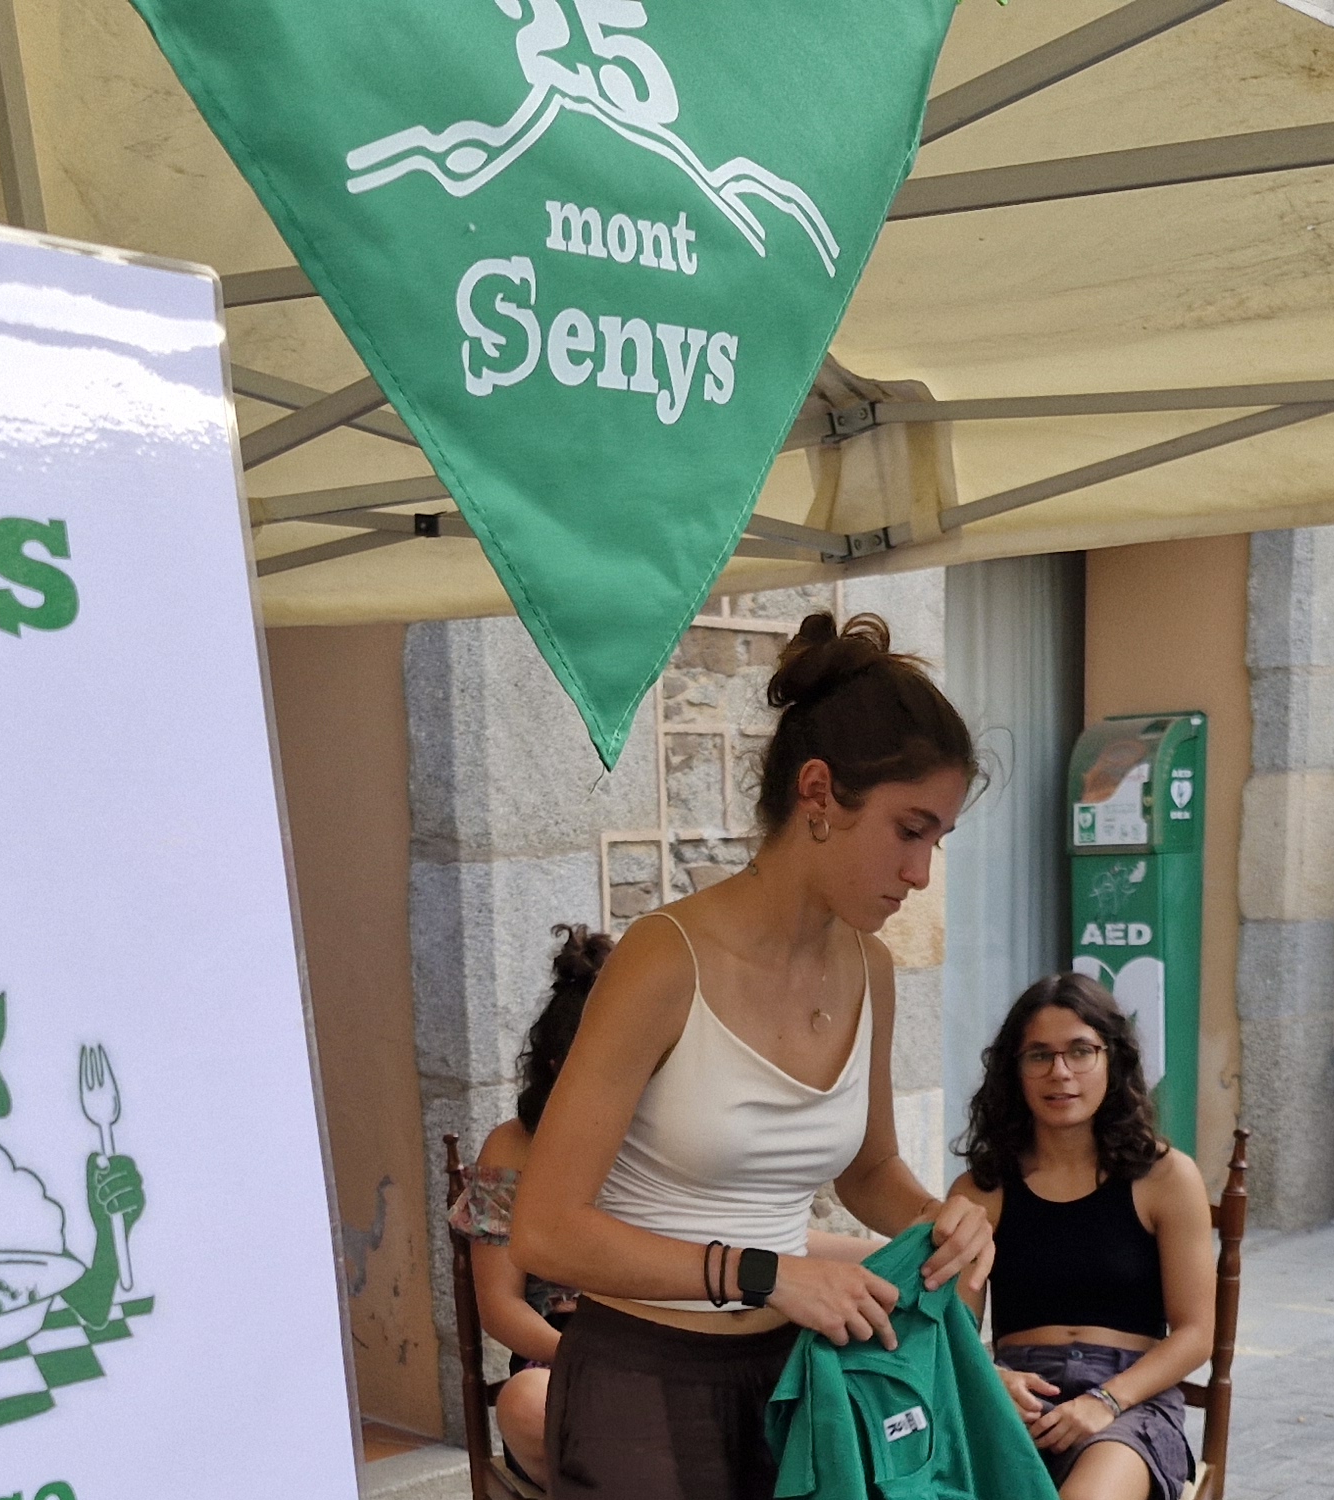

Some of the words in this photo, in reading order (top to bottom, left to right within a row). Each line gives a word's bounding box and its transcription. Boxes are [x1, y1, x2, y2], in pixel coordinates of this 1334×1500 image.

[546, 201, 698, 274] mont
[456, 256, 738, 424] Senys
[1081, 923, 1152, 945] AED
